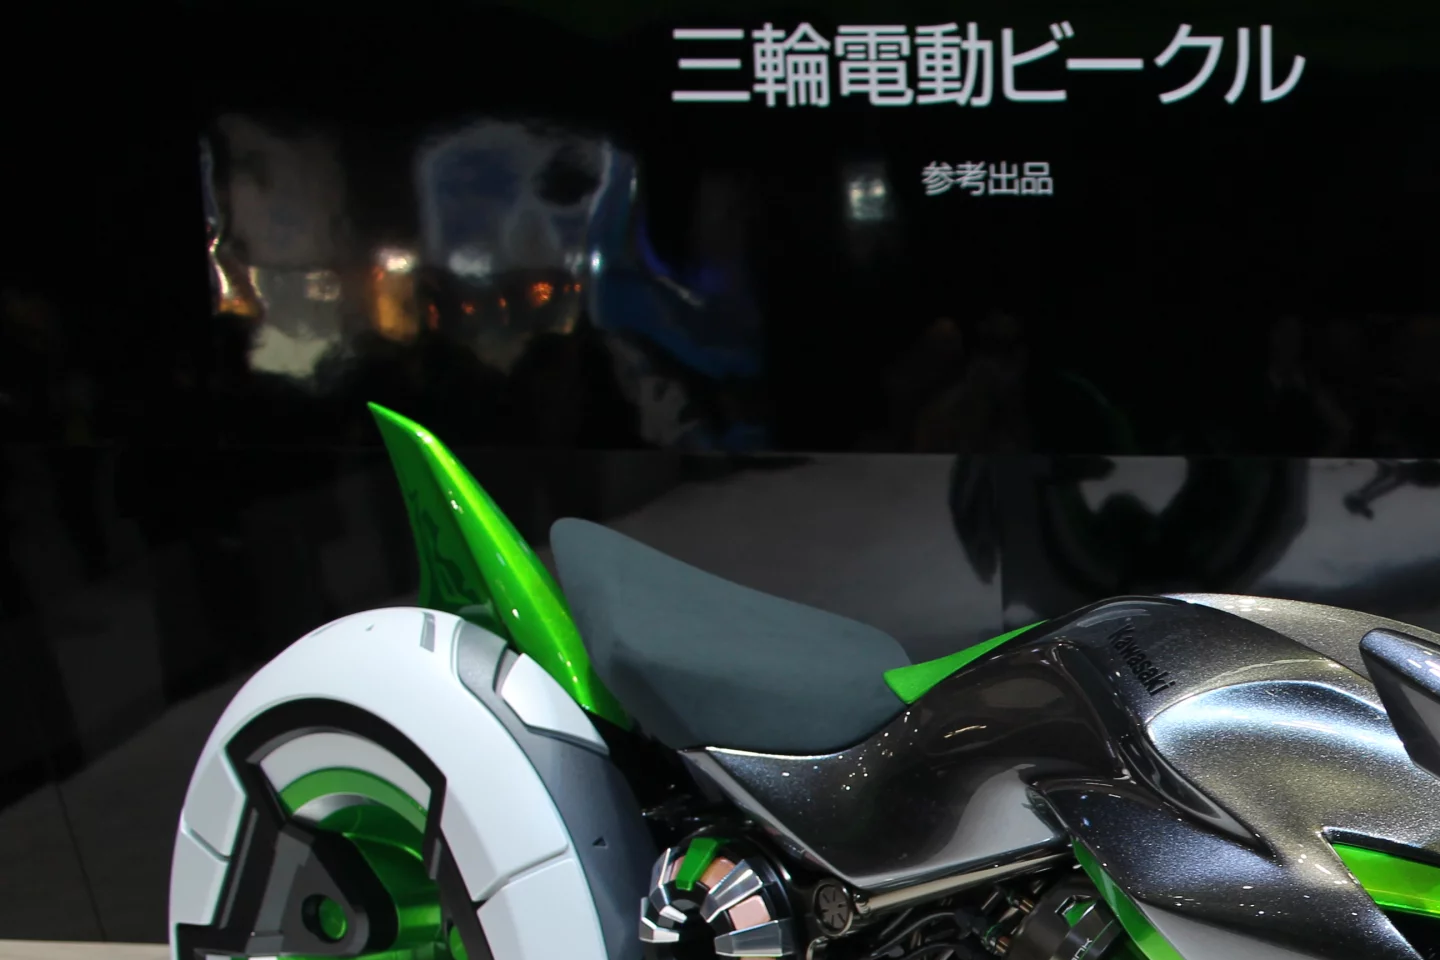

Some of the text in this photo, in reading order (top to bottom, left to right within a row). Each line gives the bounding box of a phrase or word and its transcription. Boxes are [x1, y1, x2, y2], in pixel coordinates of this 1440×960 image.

[672, 21, 1305, 107] 三輪電動ビークル
[922, 161, 1053, 196] 参考出品
[1108, 624, 1176, 696] Kawasaki
